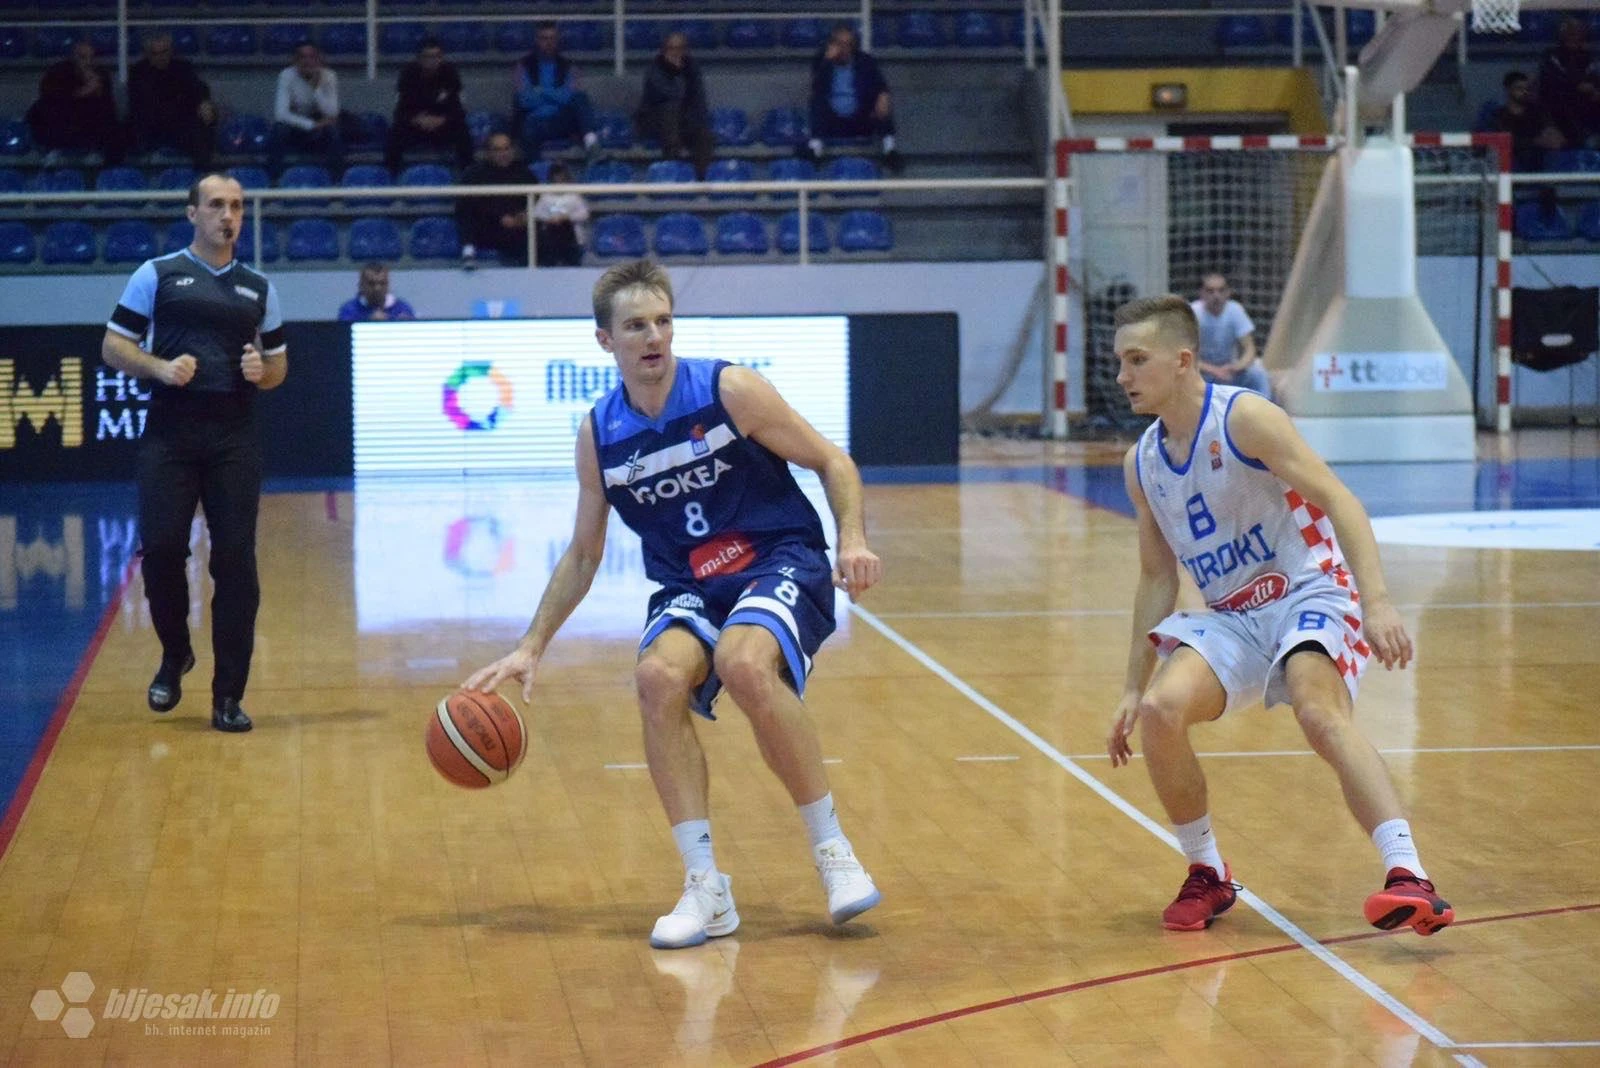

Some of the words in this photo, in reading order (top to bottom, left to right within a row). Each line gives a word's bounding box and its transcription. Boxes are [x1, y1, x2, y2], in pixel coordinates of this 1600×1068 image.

[684, 501, 710, 538] 8
[1186, 491, 1217, 541] 8
[774, 580, 800, 607] 8
[1297, 610, 1327, 632] 8
